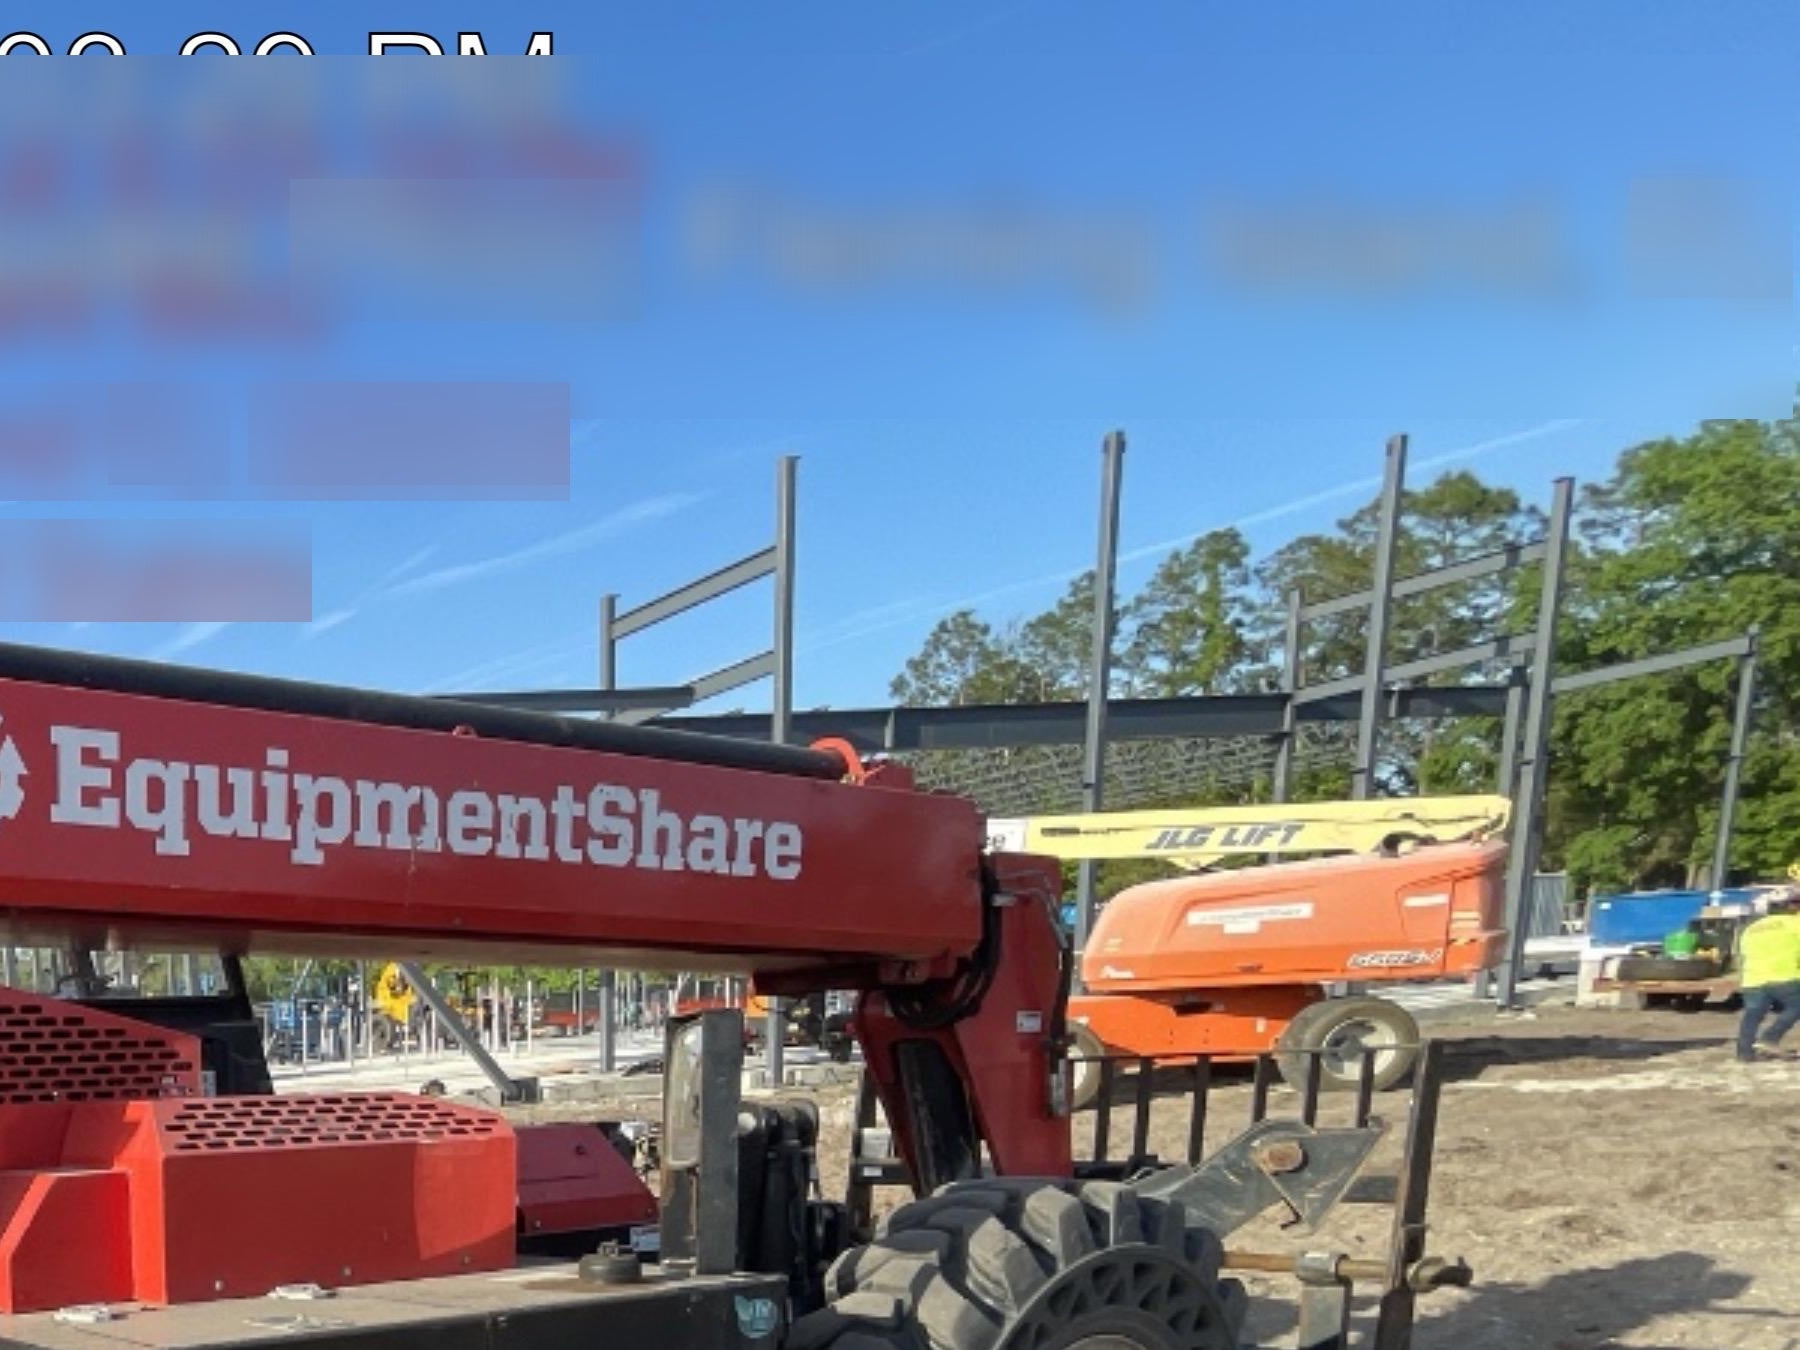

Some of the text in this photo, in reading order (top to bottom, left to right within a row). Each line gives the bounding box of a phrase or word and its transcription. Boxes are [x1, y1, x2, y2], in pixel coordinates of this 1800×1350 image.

[50, 724, 803, 881] EquipmentShare
[1145, 823, 1305, 849] JLG LIFT
